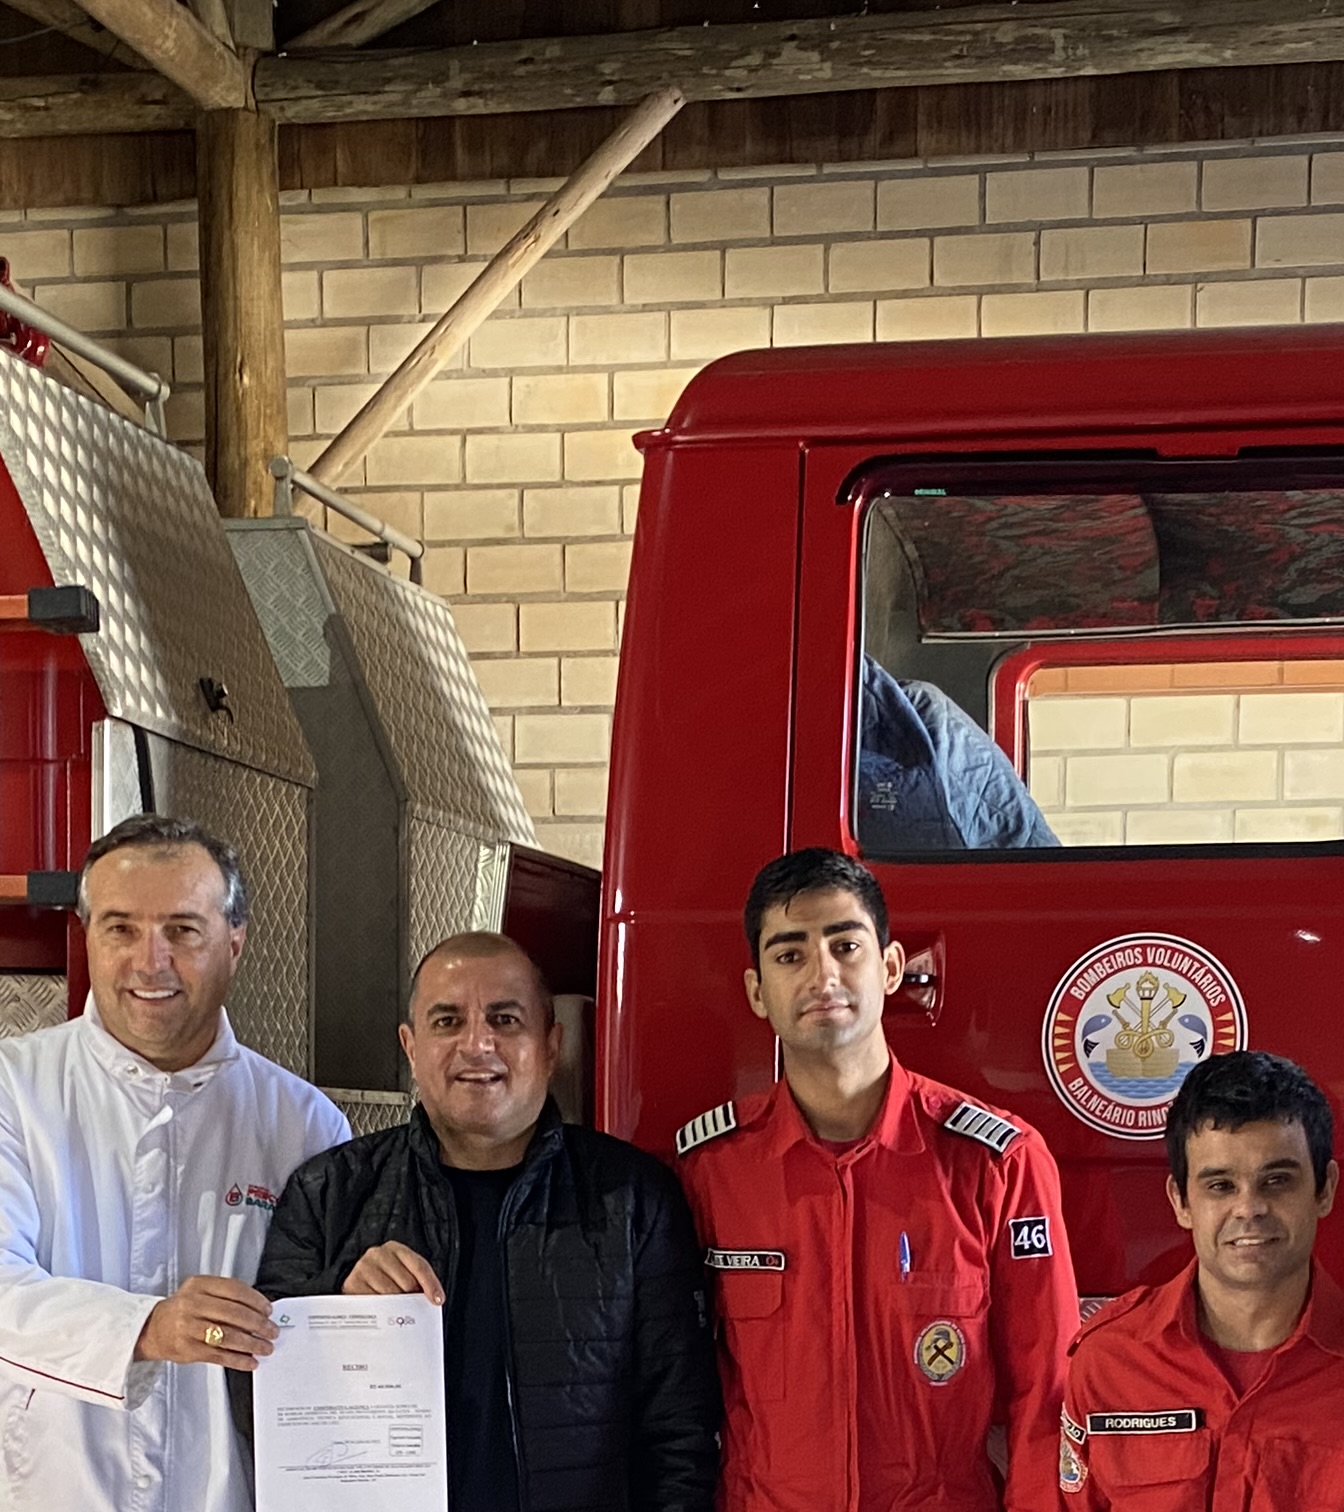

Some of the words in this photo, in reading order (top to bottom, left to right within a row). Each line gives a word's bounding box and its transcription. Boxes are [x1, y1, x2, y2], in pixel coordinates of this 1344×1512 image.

[1069, 948, 1143, 1000] BOMBEIROS
[1146, 947, 1226, 1007] VOLUNTÁRIOS
[1068, 1077, 1139, 1127] BALNEÁRIO
[1138, 1103, 1172, 1127] RINC
[1014, 1224, 1046, 1250] 46
[1105, 1416, 1177, 1429] RODRIGUES
